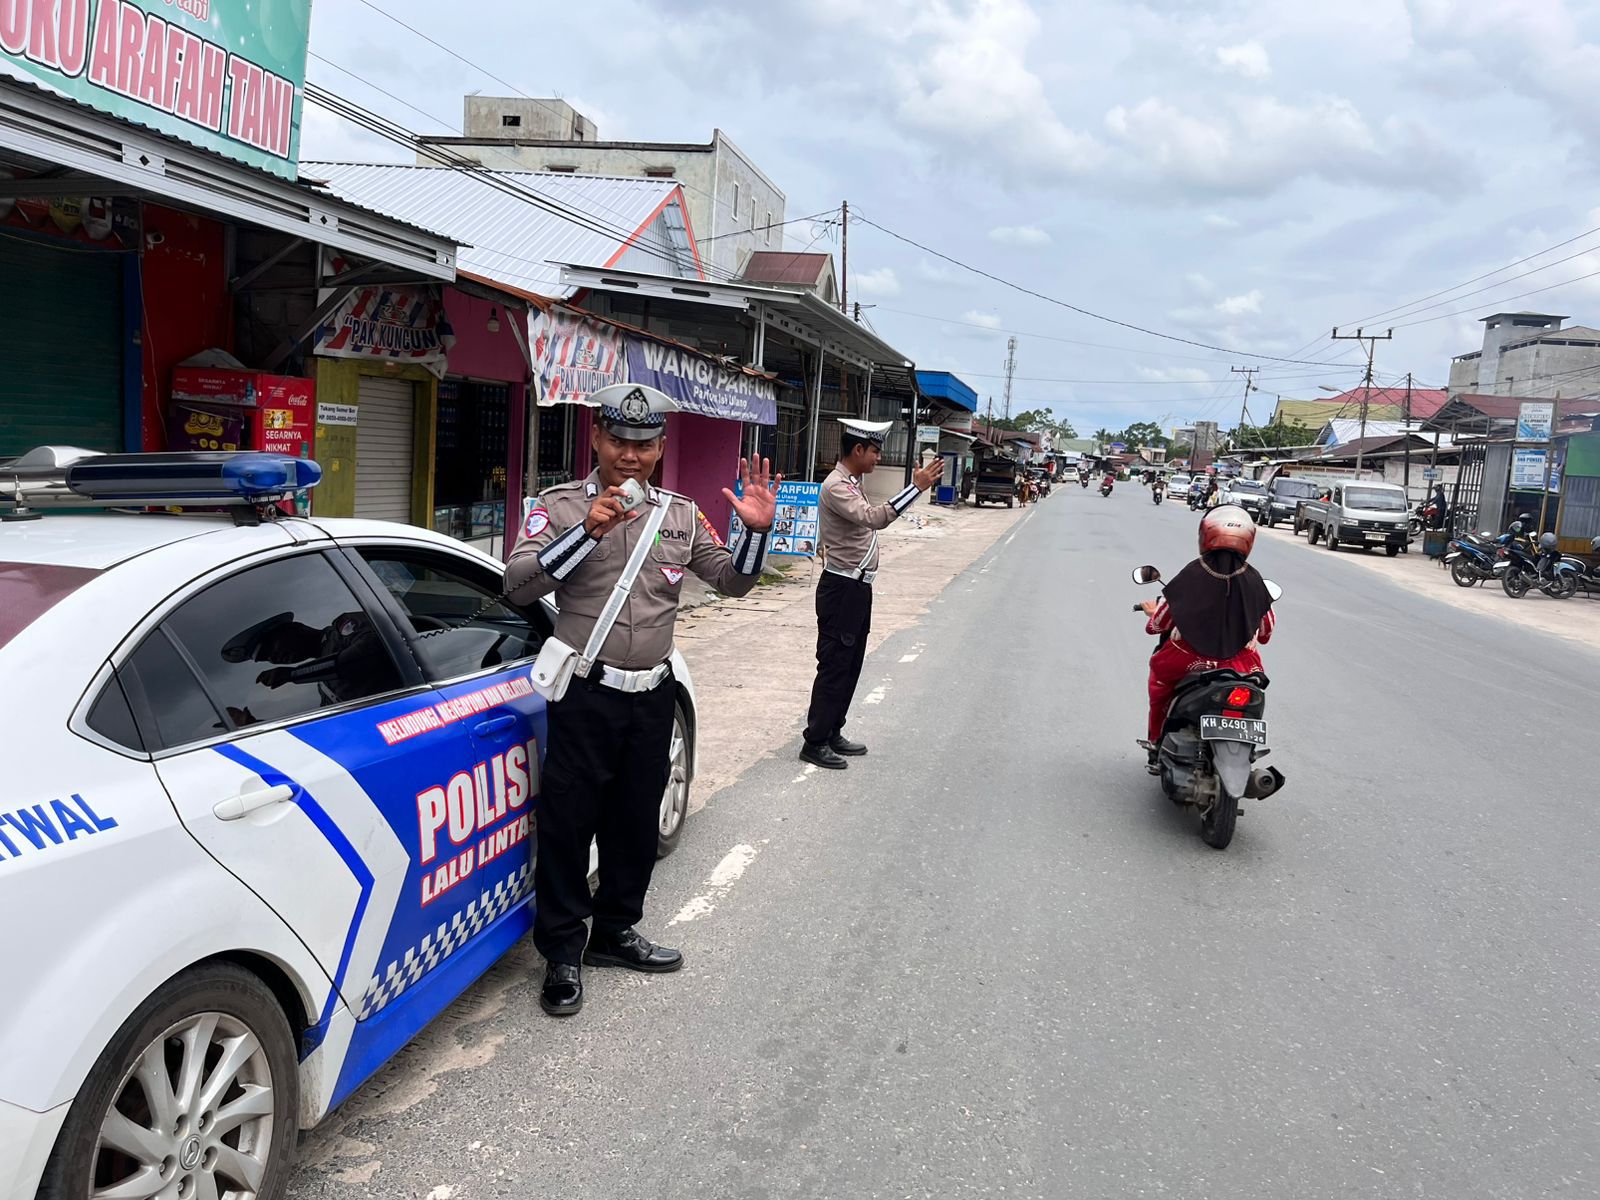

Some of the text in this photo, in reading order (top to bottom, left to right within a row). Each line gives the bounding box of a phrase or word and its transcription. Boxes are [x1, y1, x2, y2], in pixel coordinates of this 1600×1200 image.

[89, 0, 227, 132] ARAFAH
[229, 53, 293, 157] TANI
[642, 341, 775, 400] WANGI PARFUM
[265, 430, 302, 440] SEGARNYA
[265, 443, 291, 452] NIKMAT
[1202, 717, 1266, 733] KH 6490 NL
[0, 793, 119, 861] TWAL
[417, 738, 540, 864] POLISI
[421, 809, 537, 906] LALU LINTAS
